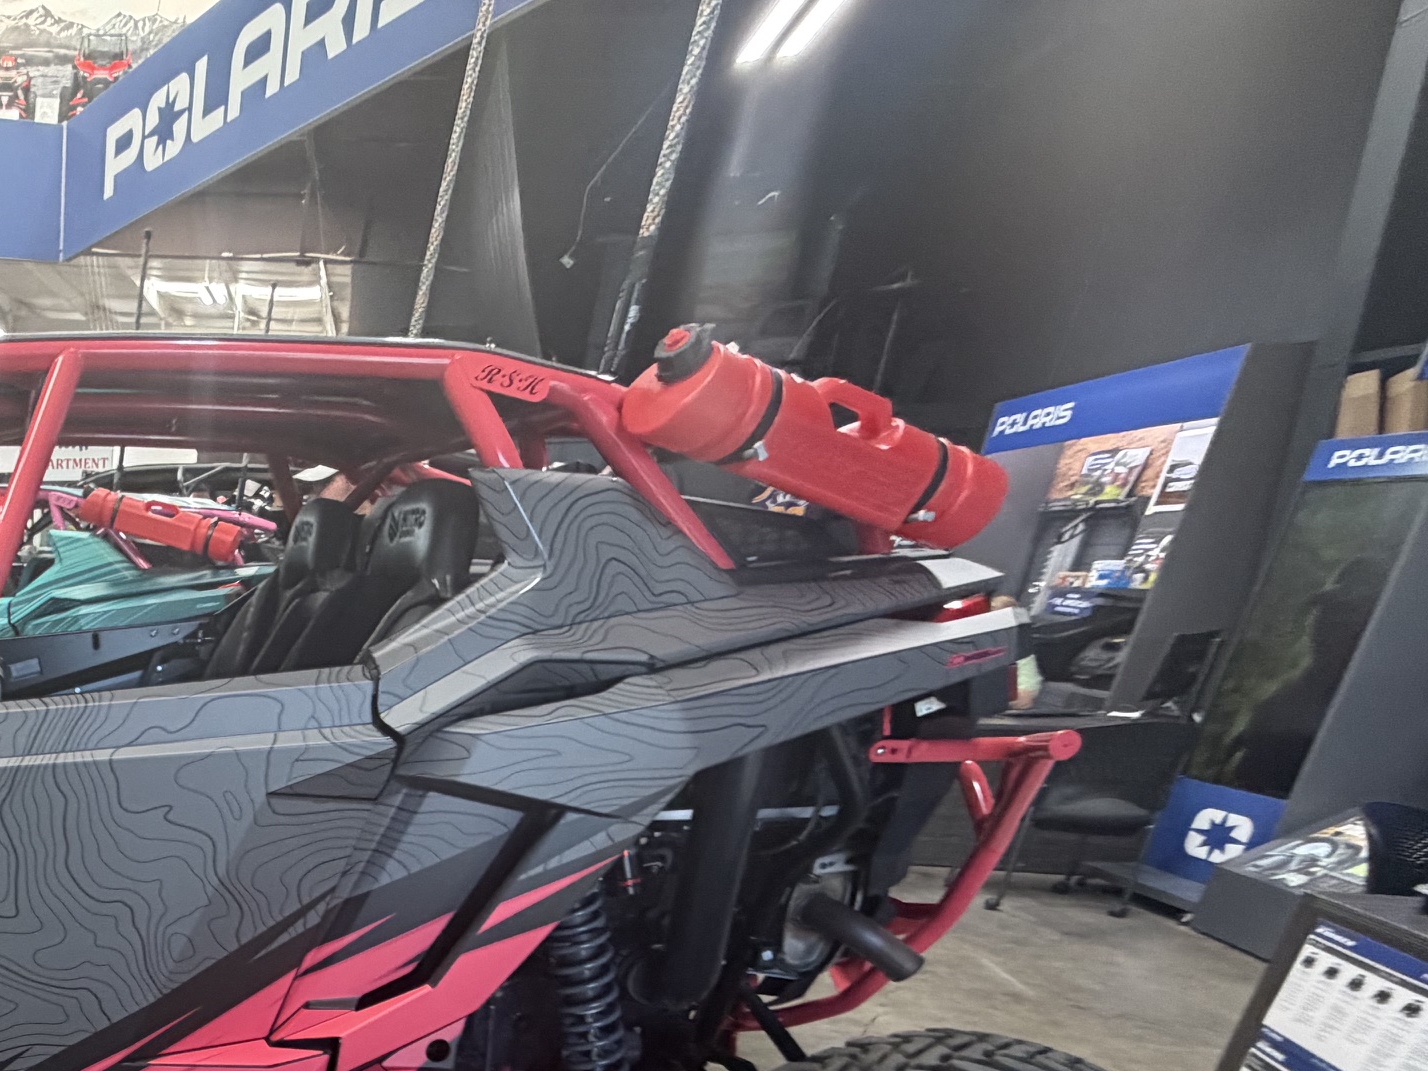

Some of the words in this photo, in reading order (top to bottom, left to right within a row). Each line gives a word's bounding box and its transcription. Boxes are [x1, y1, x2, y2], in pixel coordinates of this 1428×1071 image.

[103, 0, 425, 201] POLARI
[991, 402, 1076, 437] POLARIS
[1327, 444, 1428, 468] POLAR
